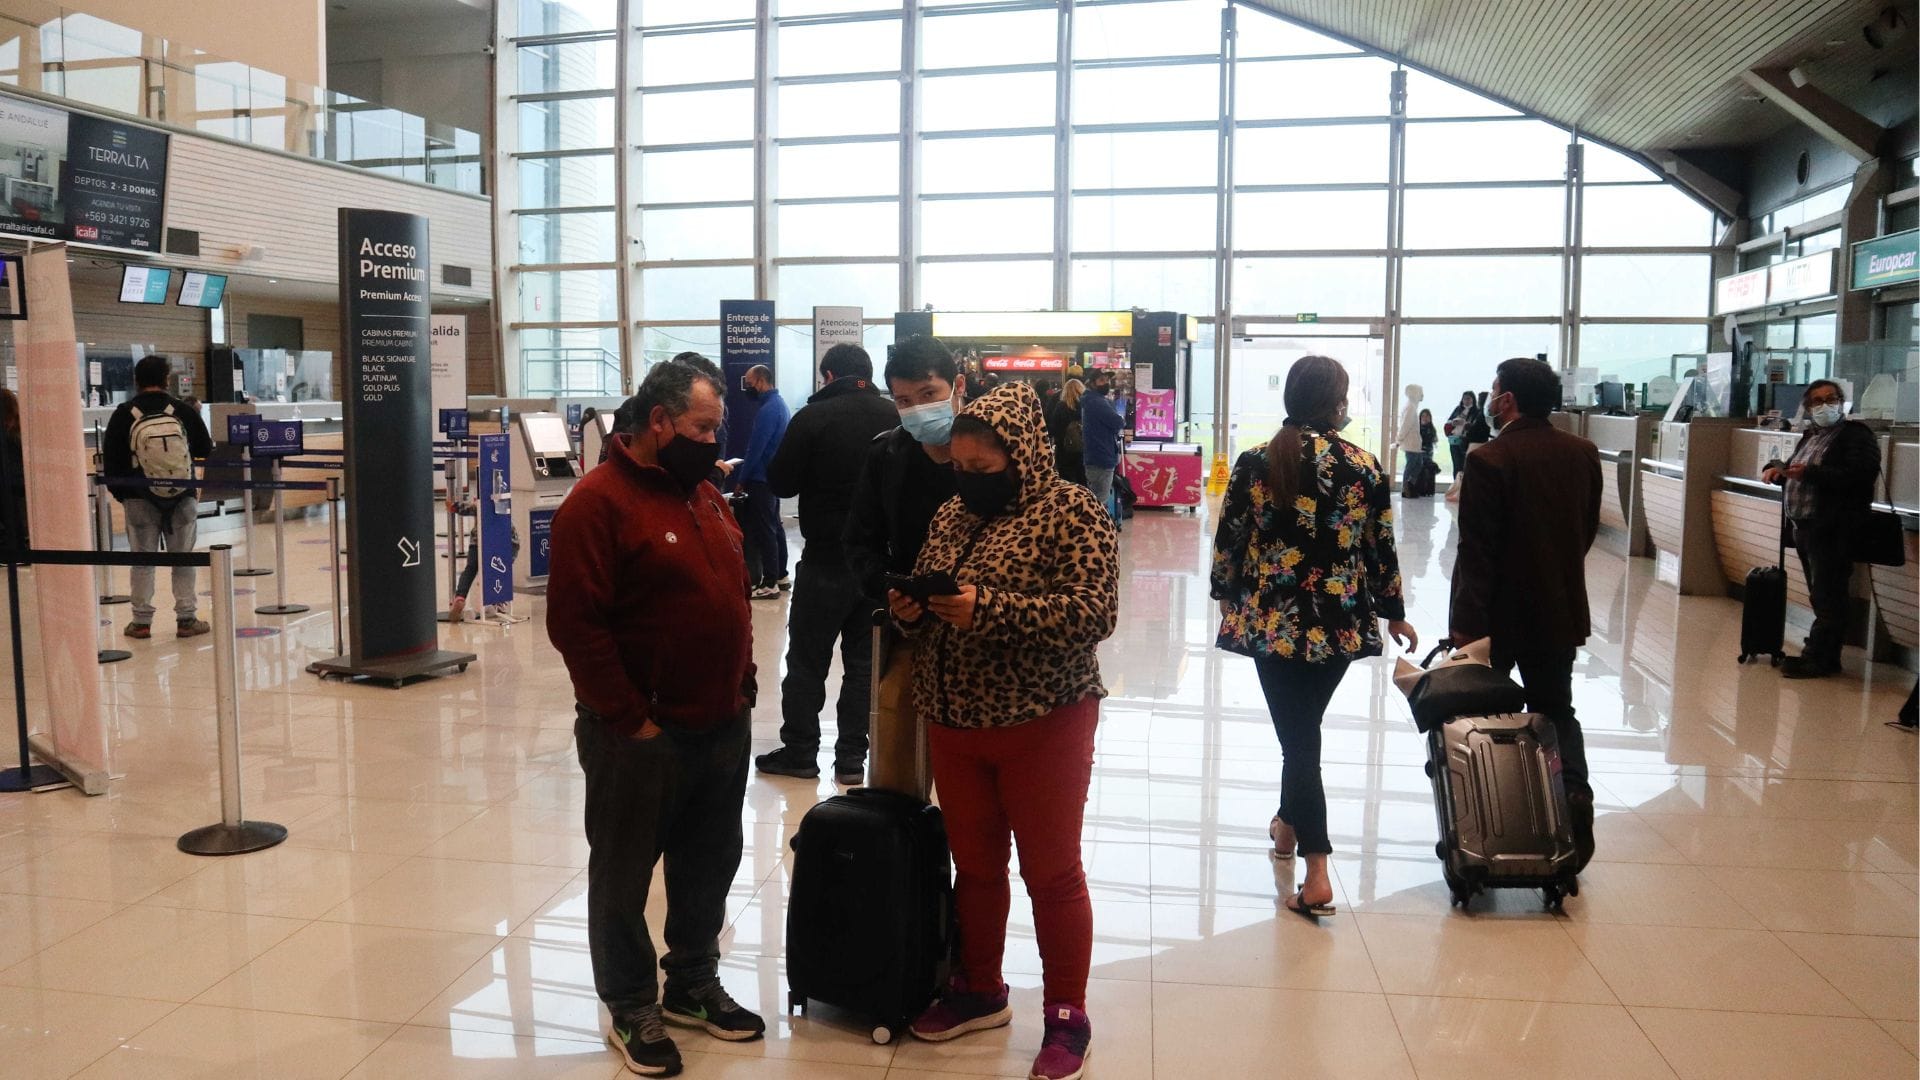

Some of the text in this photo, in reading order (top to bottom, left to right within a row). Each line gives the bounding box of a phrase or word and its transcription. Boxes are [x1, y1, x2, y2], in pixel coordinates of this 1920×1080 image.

[88, 146, 149, 170] TERRALTA
[110, 182, 116, 190] 2
[122, 184, 127, 192] 3
[129, 185, 158, 197] DORMS.
[85, 211, 150, 228] +569 3421 9726
[360, 237, 416, 259] Acceso
[1869, 251, 1917, 276] Europcar
[360, 259, 425, 281] Premium
[360, 289, 402, 300] Premium
[727, 313, 770, 324] Entrega de
[820, 319, 859, 327] Atenciones
[361, 329, 391, 337] CABINAS
[430, 324, 460, 336] alida
[727, 324, 762, 335] Equipaje
[820, 328, 858, 337] Especiales
[361, 338, 393, 346] PREMIUM
[727, 335, 771, 346] Etiquetado
[362, 355, 416, 363] BLACK SIGNATURE
[362, 374, 398, 382] PLATINUM
[363, 384, 400, 392] GOLD PLUS
[363, 394, 383, 402] GOLD
